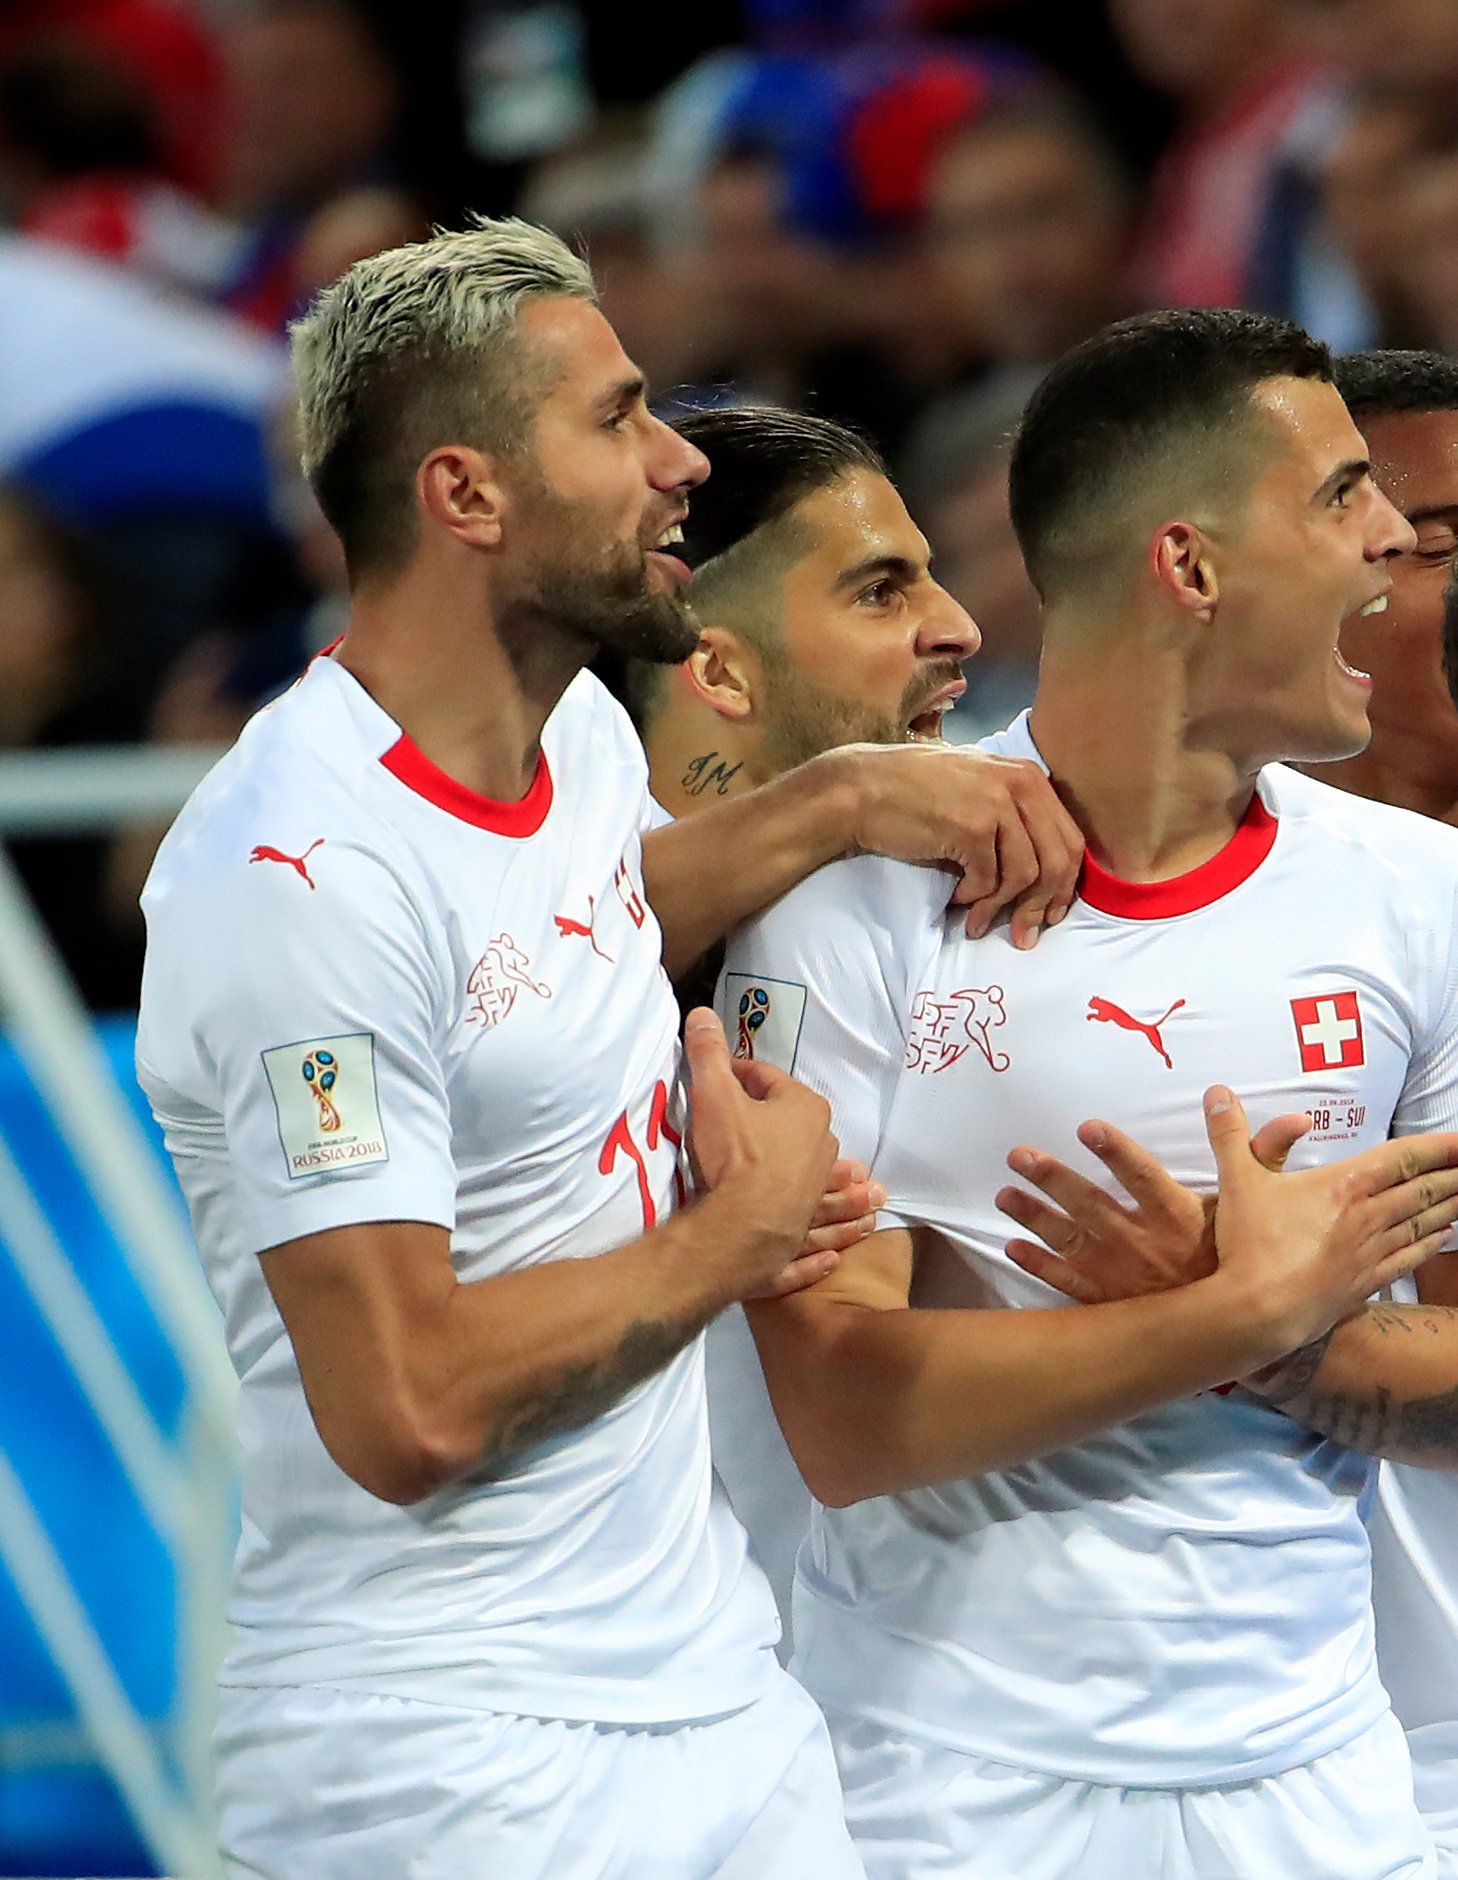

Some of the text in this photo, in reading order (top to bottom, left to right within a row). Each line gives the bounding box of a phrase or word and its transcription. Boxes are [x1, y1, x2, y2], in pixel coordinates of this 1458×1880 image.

[1305, 1109, 1330, 1130] RB
[1346, 1106, 1366, 1128] SUI
[293, 1140, 382, 1168] RUSSIA 2018
